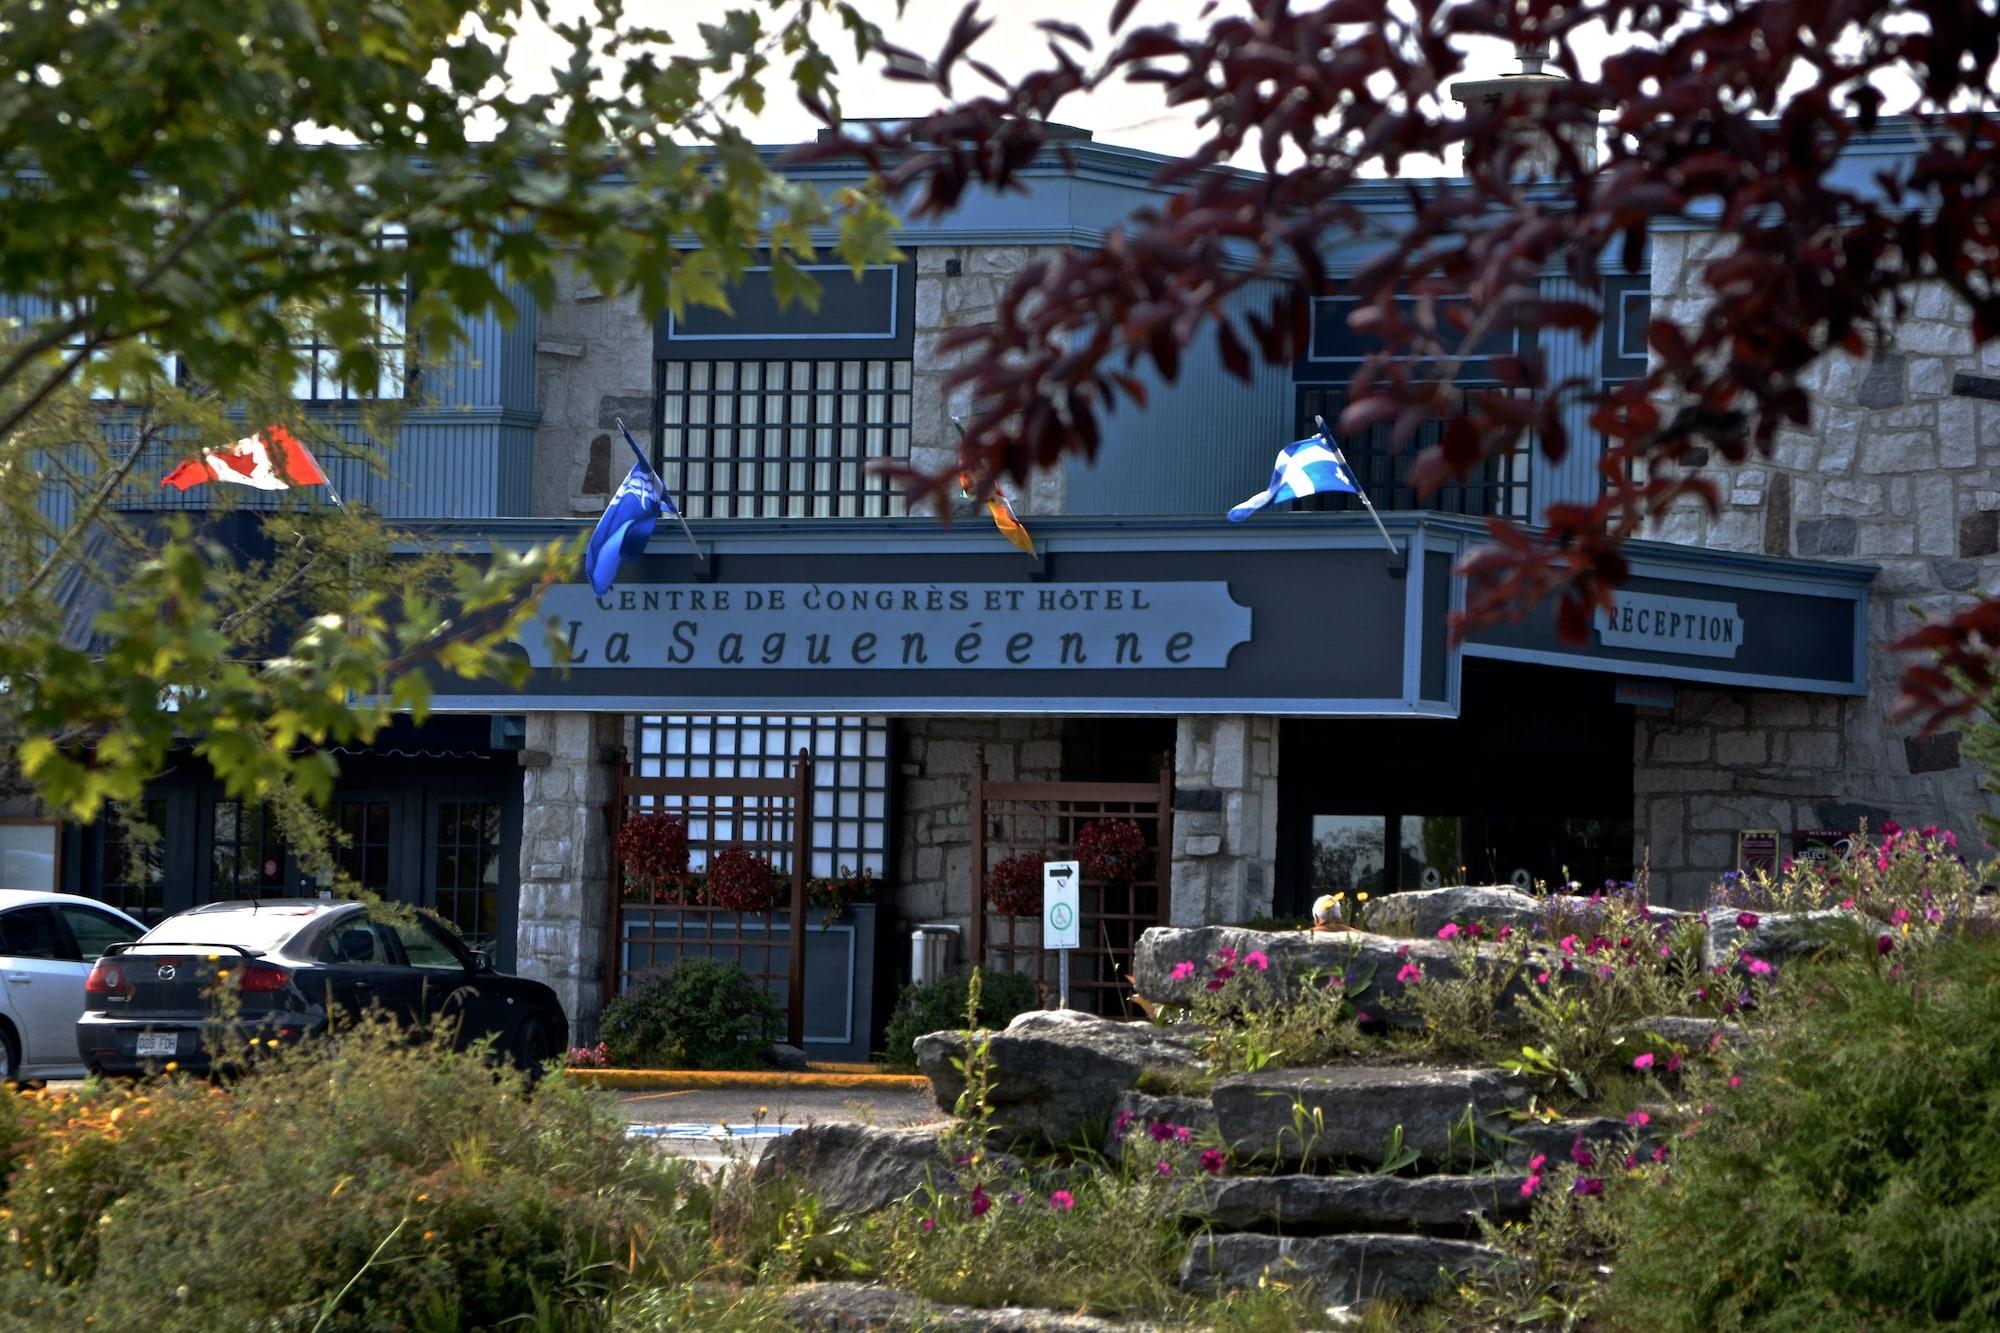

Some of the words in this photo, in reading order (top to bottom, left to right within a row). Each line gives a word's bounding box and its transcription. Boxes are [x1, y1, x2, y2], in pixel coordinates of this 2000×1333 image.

[744, 589, 786, 611] DE
[803, 583, 970, 611] CONGRÈS
[984, 589, 1025, 611] ET
[567, 620, 631, 664] La
[667, 620, 1195, 665] Saguenéenne
[1608, 600, 1734, 643] RÉCEPTION
